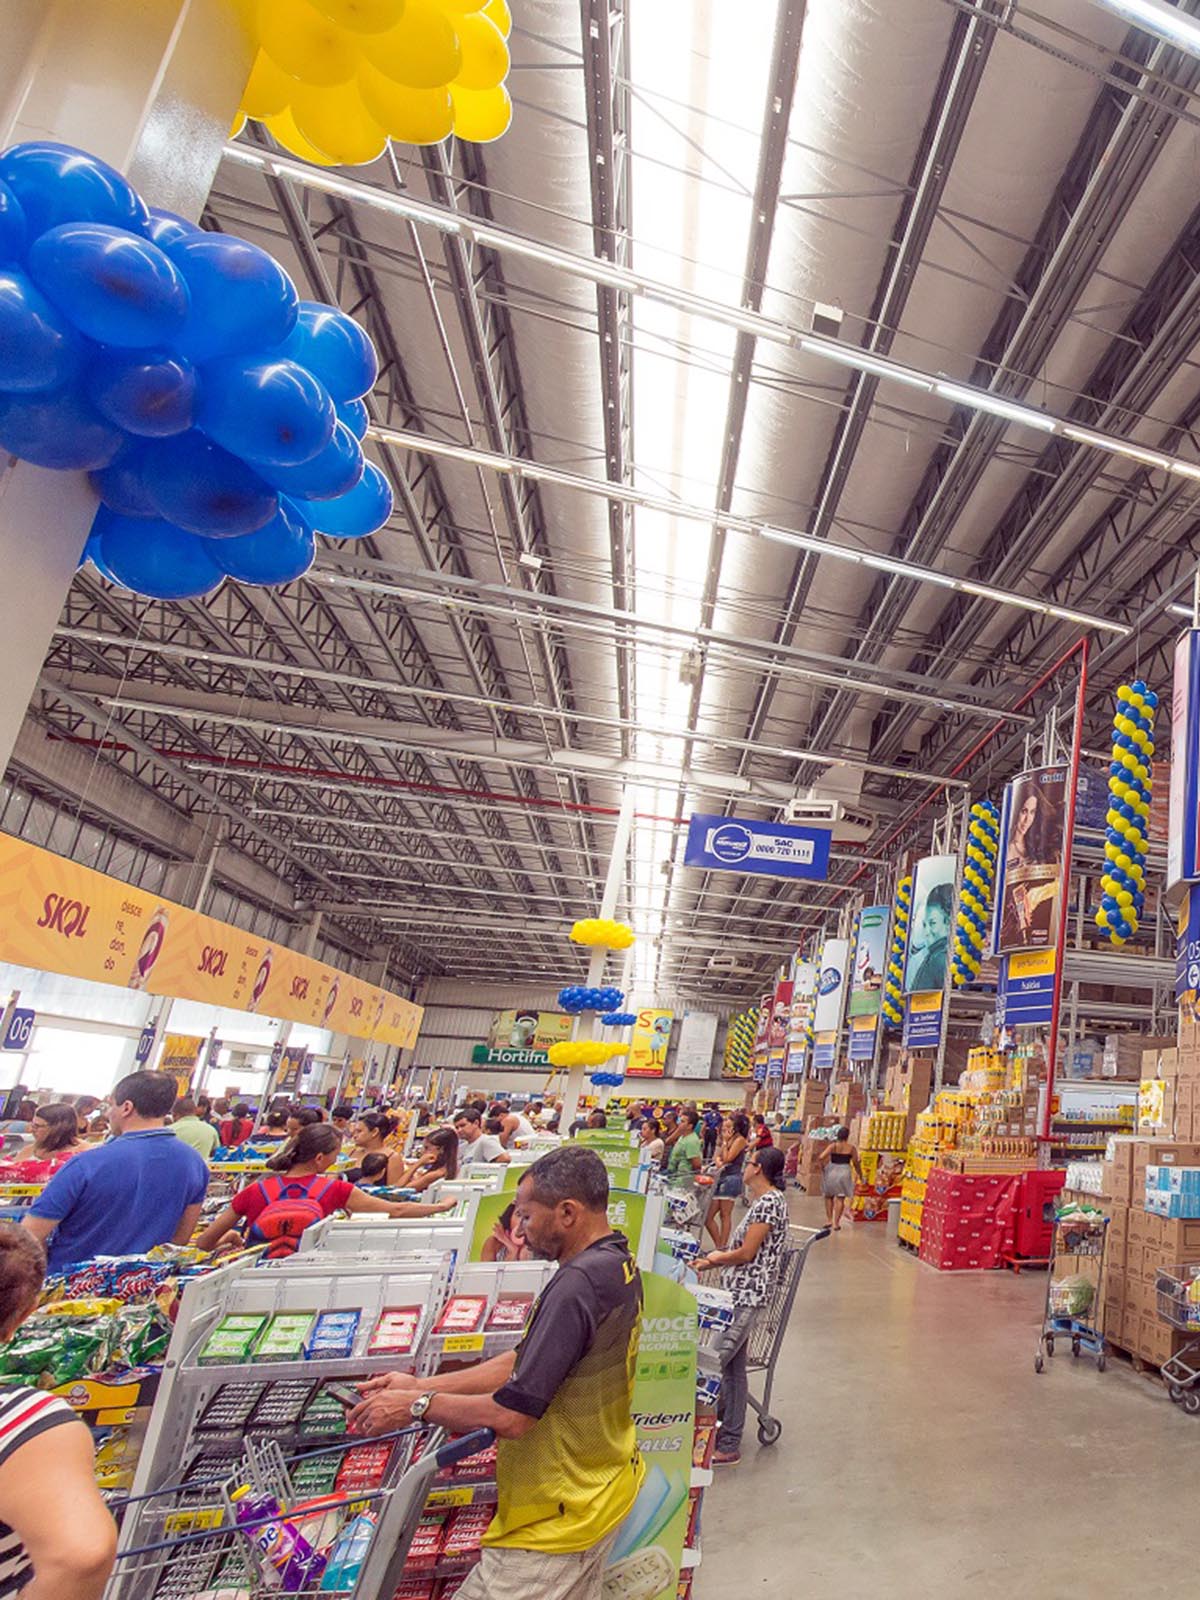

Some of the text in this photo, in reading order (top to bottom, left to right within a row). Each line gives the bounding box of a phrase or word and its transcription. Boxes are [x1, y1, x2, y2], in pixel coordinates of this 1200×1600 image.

[774, 839, 794, 848] SAC
[37, 893, 90, 938] SKOL
[197, 945, 229, 978] SKOL
[10, 1015, 33, 1041] 06
[641, 1312, 695, 1332] VOCÊ
[631, 1412, 691, 1426] Trident
[637, 1437, 683, 1453] ALLS
